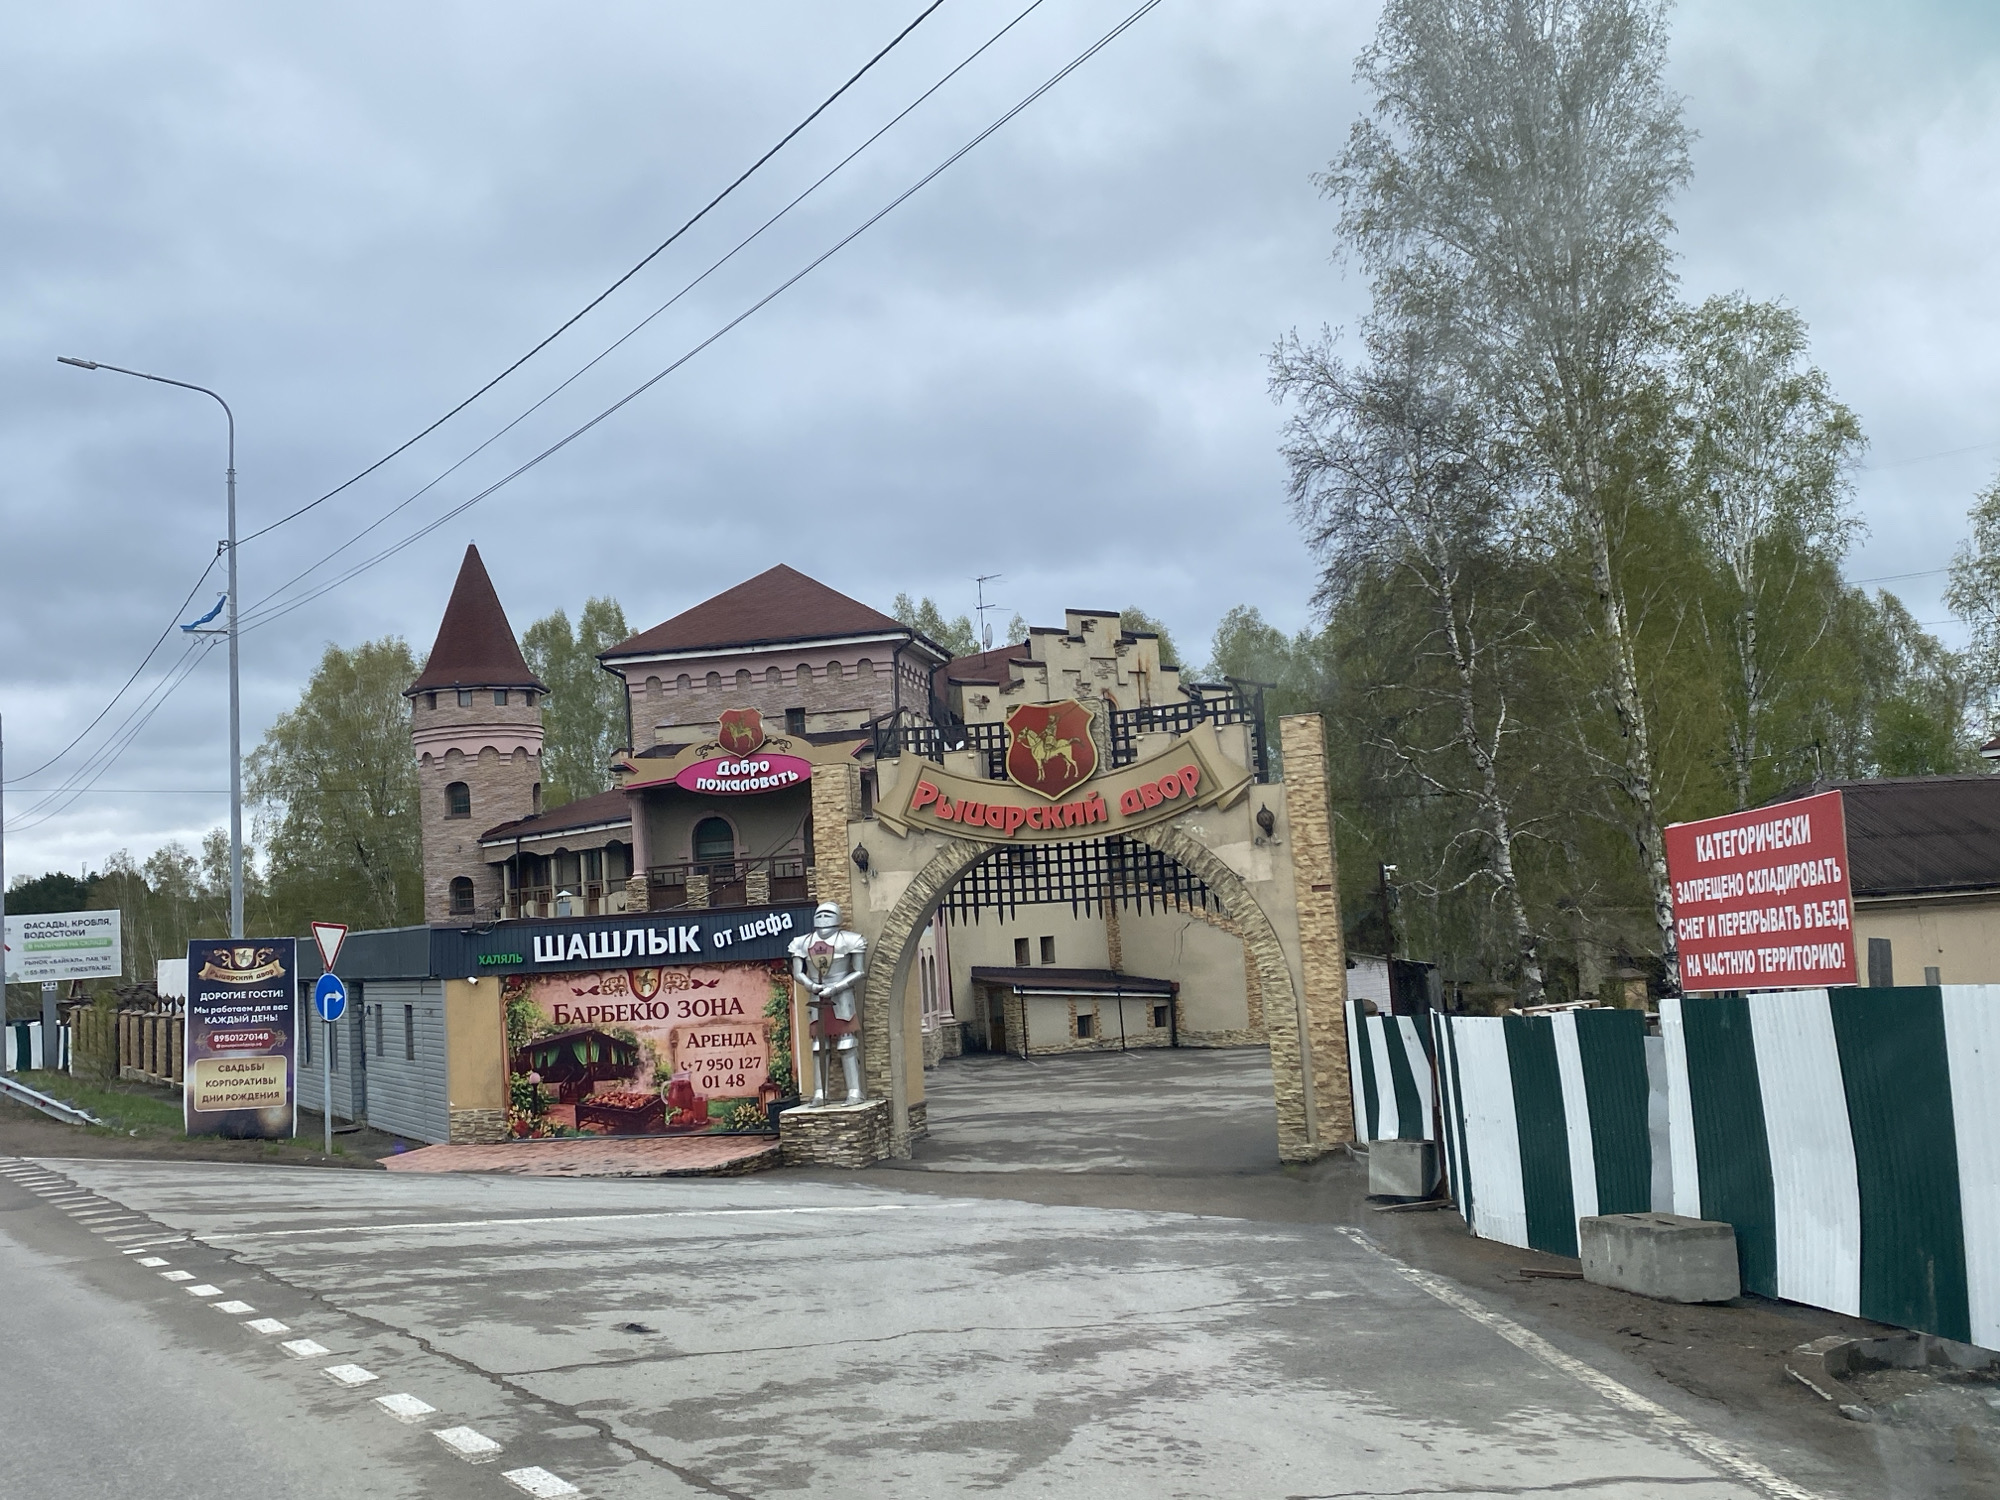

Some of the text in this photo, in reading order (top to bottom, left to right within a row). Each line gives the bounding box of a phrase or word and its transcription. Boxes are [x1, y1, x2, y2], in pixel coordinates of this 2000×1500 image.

[716, 759, 770, 776] Добро
[696, 770, 799, 792] пожаловать
[910, 764, 1200, 836] Рыцарский двор
[1695, 814, 1811, 863] КАТЕГОРИЧЕСКИ
[1676, 857, 1842, 904] ЗАПРЕЩЕНО СКЛАДИРОВАТЬ
[24, 918, 112, 930] ФАСАДЫ, КРОВЛЯ,
[1678, 899, 1849, 940] СНЕГ И ПЕРЕКРЫВАТЬ ВЪЕЗД
[24, 929, 85, 939] ВОДОСТОКИ
[478, 912, 793, 965] ХАЛЯЛЬ ШАШЛЫК от шефа
[1686, 942, 1846, 977] НА ЧАСТНУЮ ТЕРРИТОРИЮ!
[209, 969, 275, 981] Рыцарский двор
[200, 989, 284, 1001] ДОРОГИЕ ГОСТИ!
[194, 1006, 209, 1014] Мы
[211, 1005, 253, 1014] работаем
[255, 1004, 271, 1012] для
[553, 997, 745, 1025] БАРБЕКЮ ЗОНА
[204, 1014, 278, 1024] КАЖДЫЙ ДЕНЬ!
[213, 1033, 269, 1042] 89501270148
[686, 1032, 757, 1048] АРЕНДА
[218, 1063, 265, 1072] СВАДЬБЫ
[707, 1058, 734, 1071] 950
[738, 1056, 761, 1069] 127
[205, 1077, 276, 1087] КОРПОРАТИВЫ
[702, 1073, 746, 1088] 01 48
[202, 1091, 280, 1103] ДНИ РОЖДЕНИЯ
